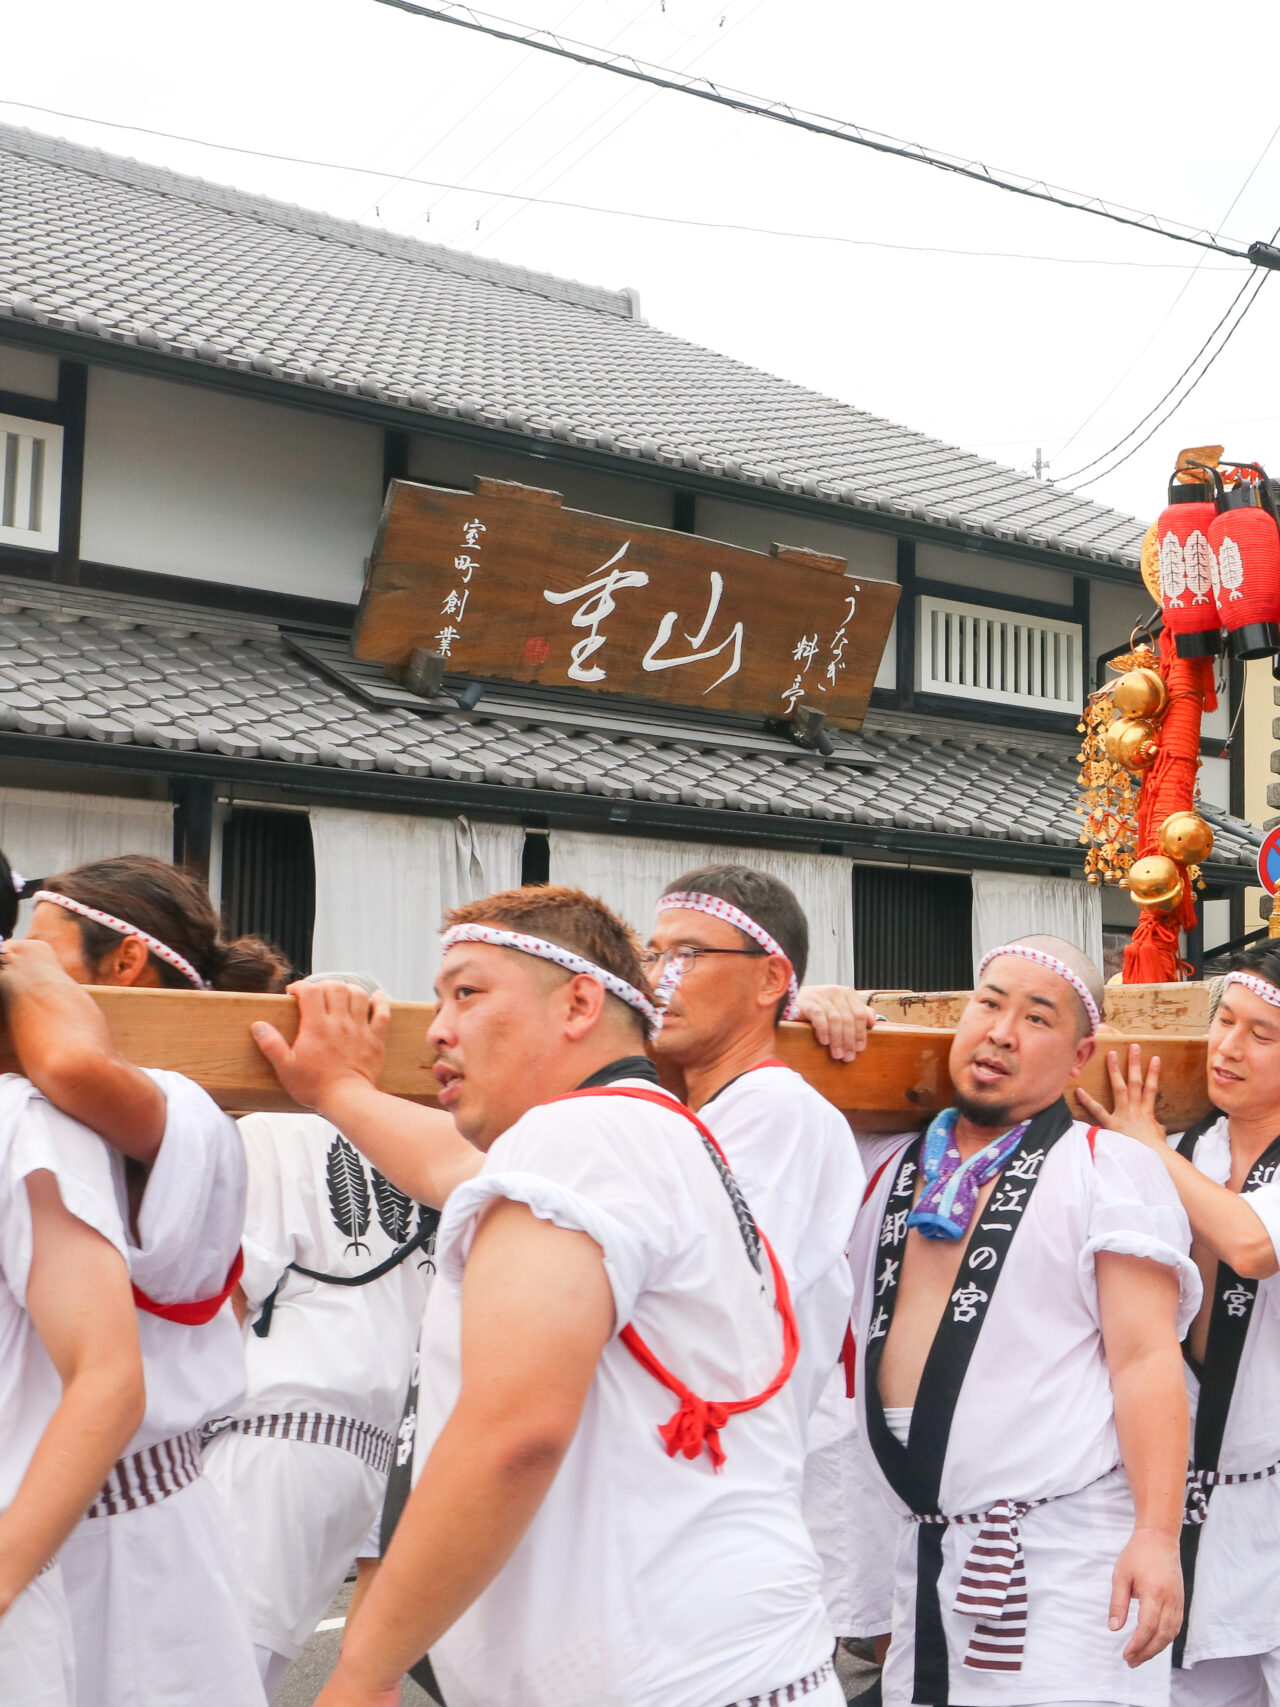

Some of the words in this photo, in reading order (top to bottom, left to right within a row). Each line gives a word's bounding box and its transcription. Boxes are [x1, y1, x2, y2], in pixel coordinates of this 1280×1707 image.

[433, 517, 487, 657] 室町創業
[817, 584, 861, 692] うなぎ
[781, 632, 820, 715] 料亭
[951, 1148, 1046, 1323] 近江一の宮
